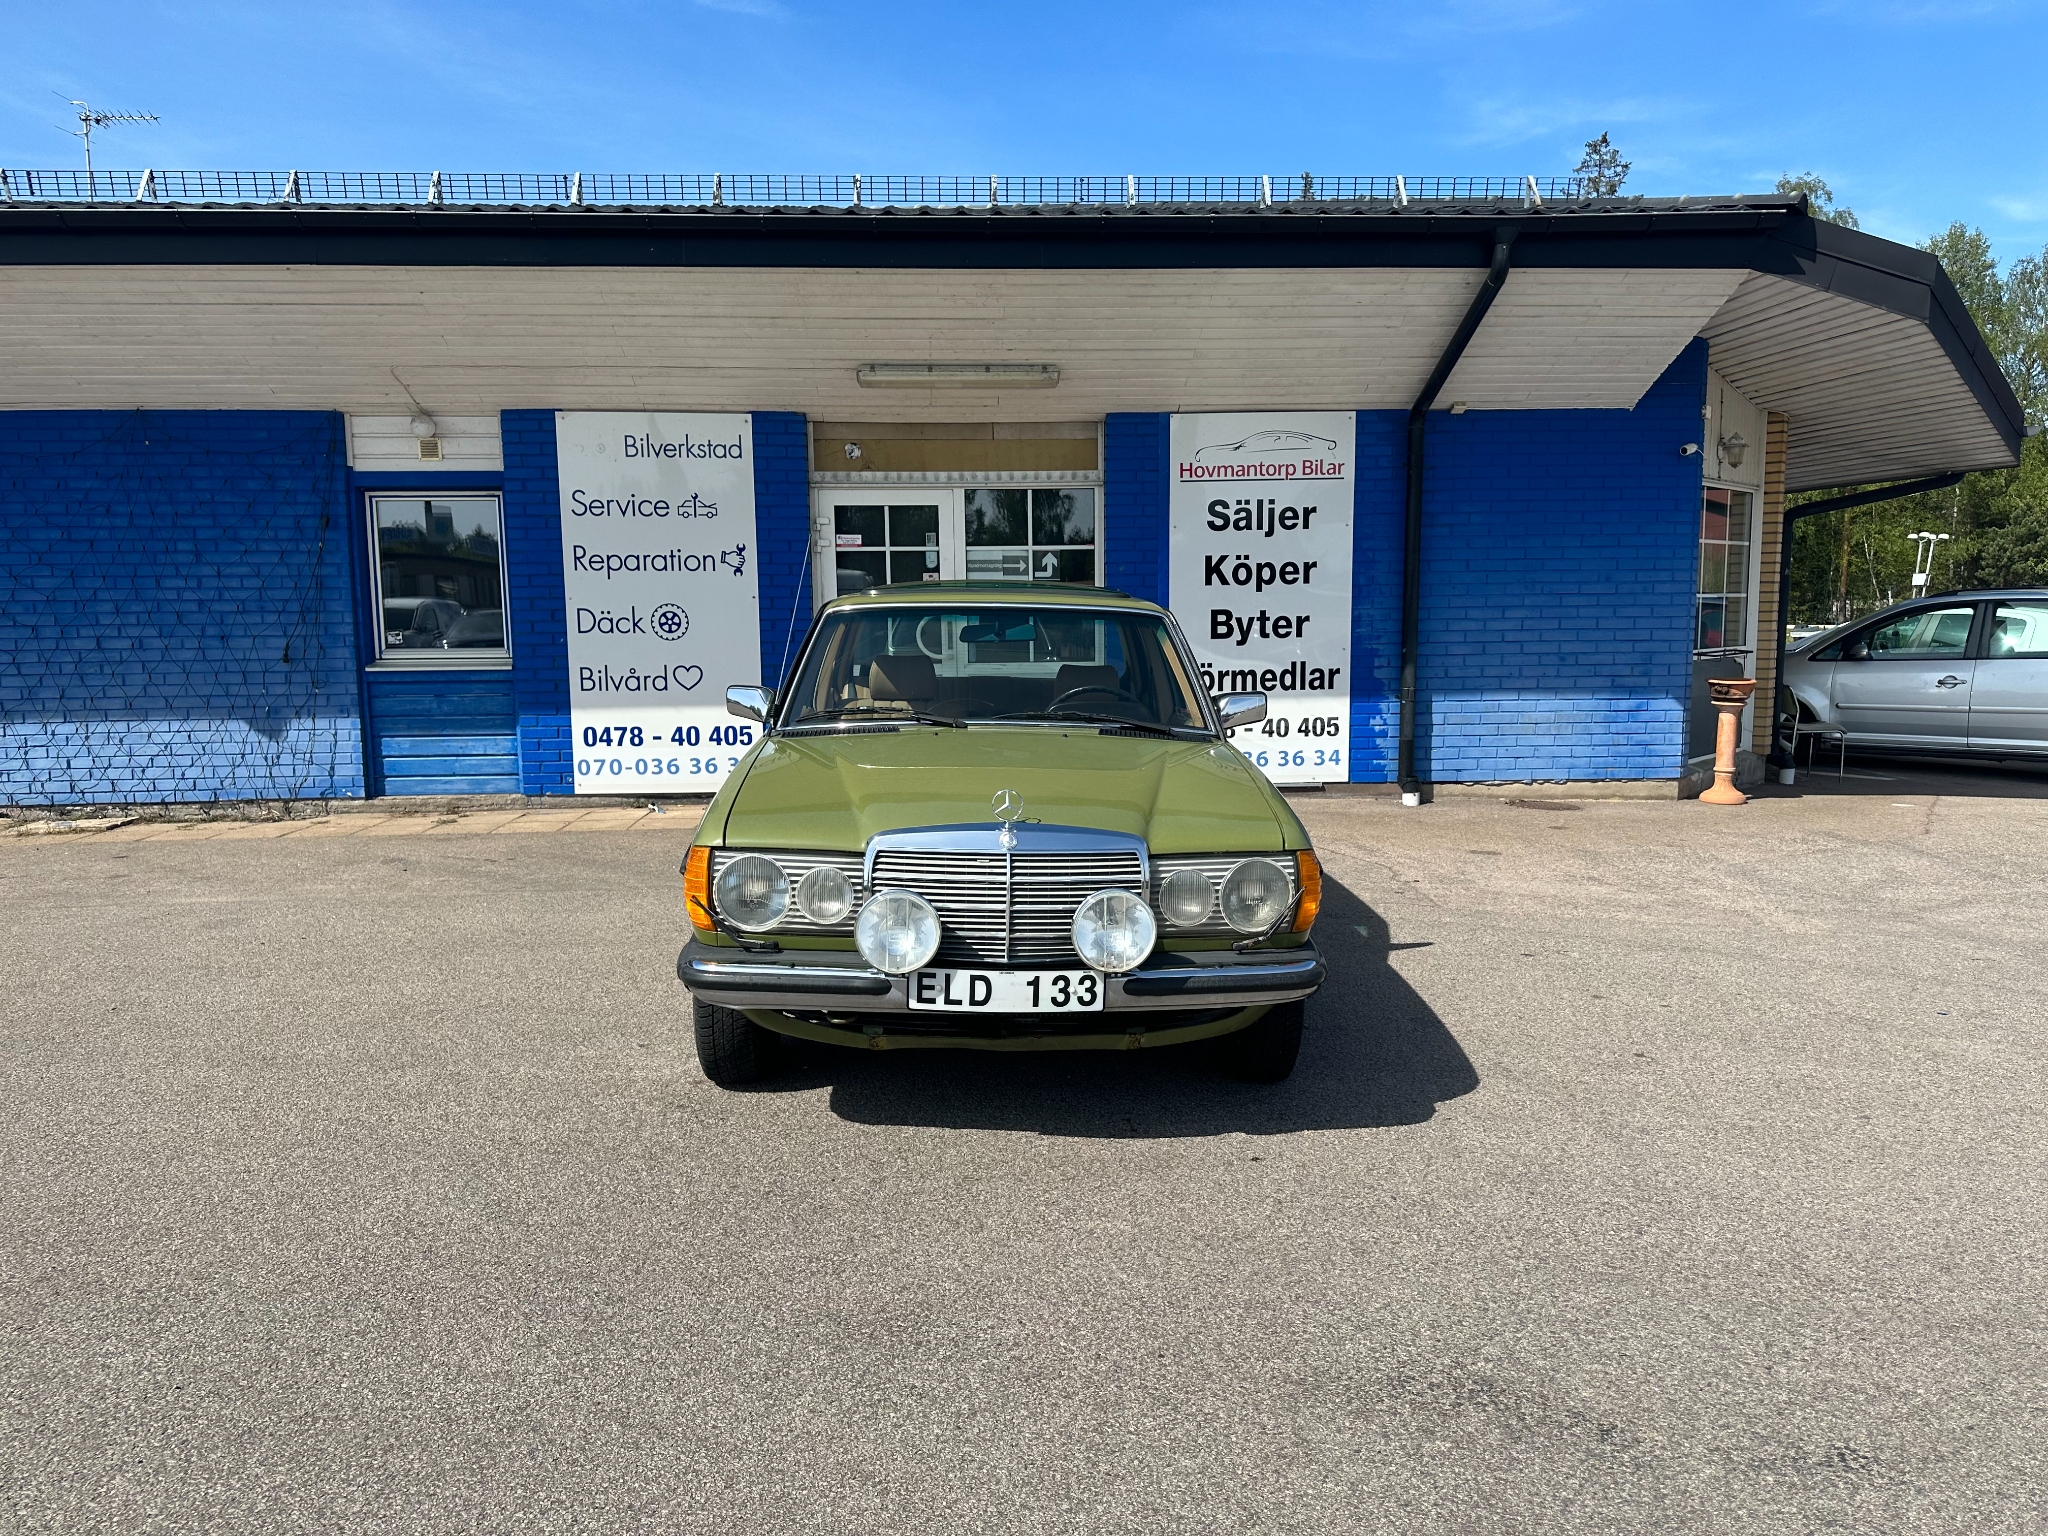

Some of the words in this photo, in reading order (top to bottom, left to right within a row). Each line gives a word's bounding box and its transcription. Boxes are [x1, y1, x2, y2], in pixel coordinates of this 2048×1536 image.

[623, 433, 743, 459] Bilverkstad
[1179, 461, 1297, 480] Hovmantorp
[1302, 459, 1345, 476] Bilar
[571, 489, 670, 518] Service
[1206, 498, 1317, 538] Säljer
[572, 544, 716, 580] Reparation
[1204, 554, 1318, 593] Köper
[576, 605, 647, 634] Däck
[1210, 608, 1310, 647] Byter
[579, 664, 669, 693] Bilvård
[1199, 660, 1341, 692] örmedlar
[583, 725, 644, 748] 0478
[671, 725, 701, 747] 40
[708, 725, 753, 747] 405
[1261, 717, 1290, 738] 40
[1297, 716, 1341, 737] 405
[577, 757, 681, 776] 070-036
[689, 757, 719, 775] 36
[1277, 749, 1306, 767] 36
[1313, 748, 1342, 766] 34
[916, 971, 993, 1007] ELD
[1026, 974, 1098, 1008] 133
